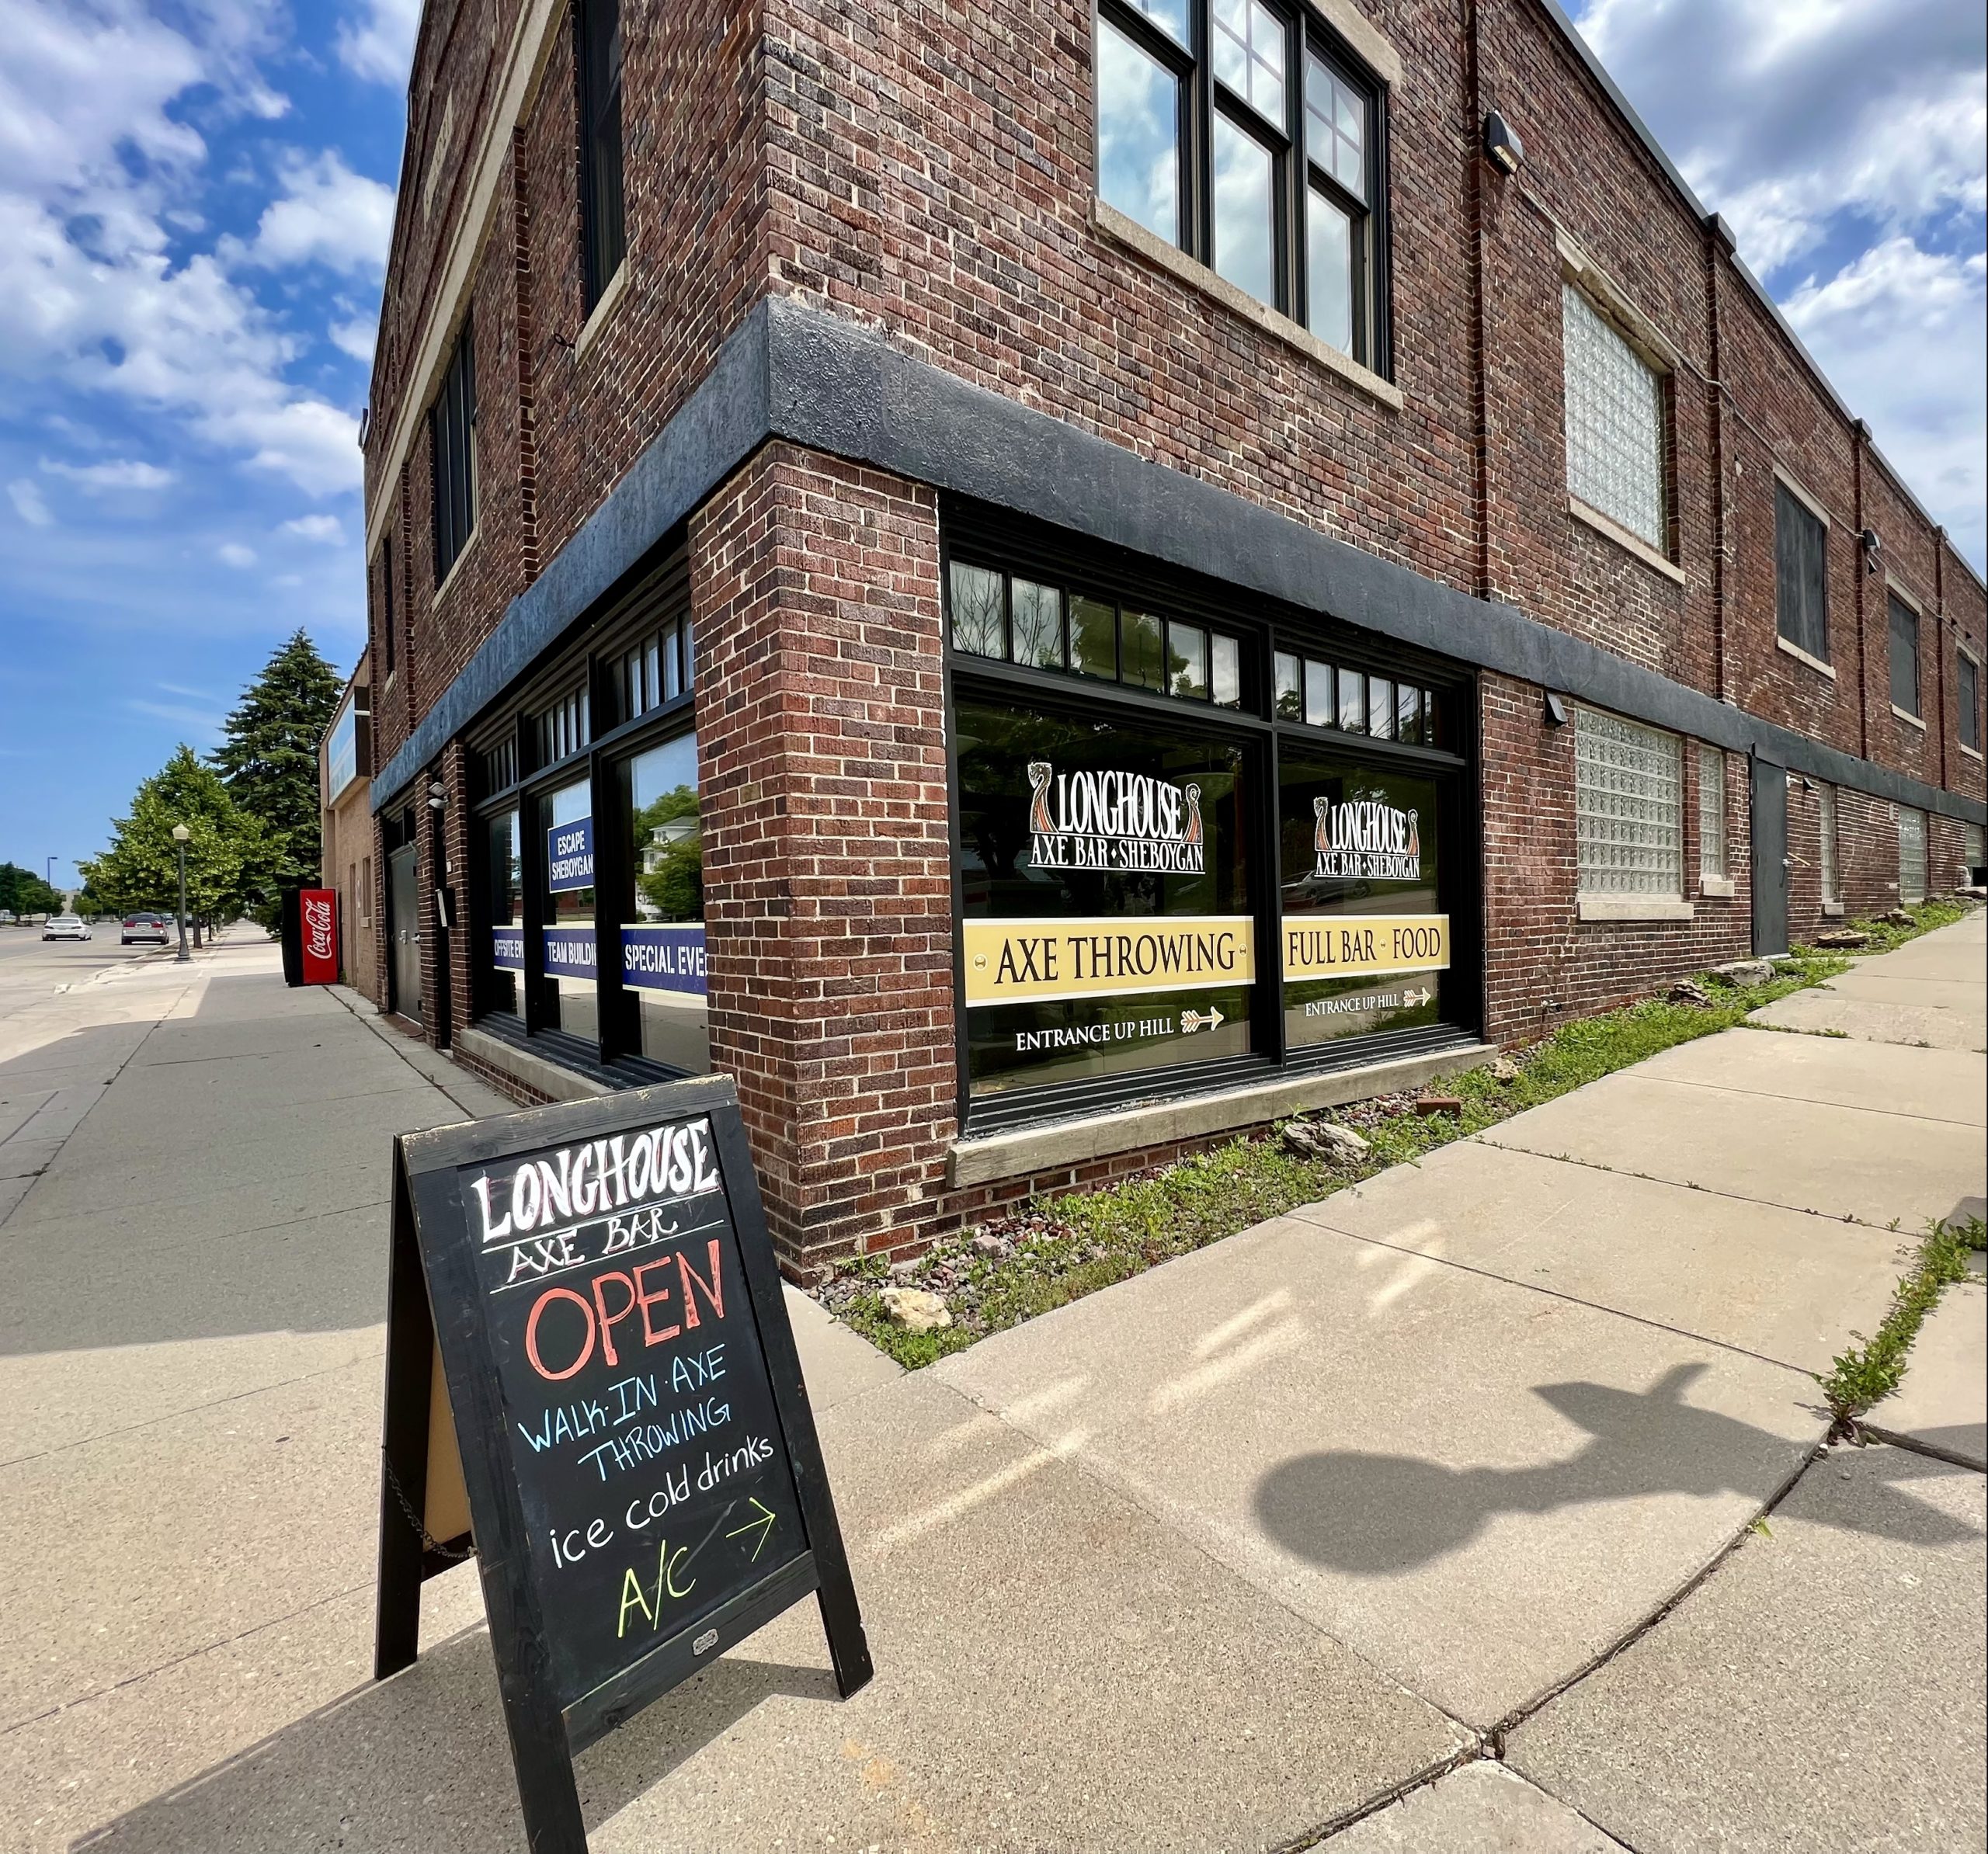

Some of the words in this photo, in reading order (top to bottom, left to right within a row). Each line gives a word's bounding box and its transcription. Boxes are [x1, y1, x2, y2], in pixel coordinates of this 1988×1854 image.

[1057, 770, 1183, 839] LONGHOUSE
[558, 830, 586, 856] ESCAPE
[1331, 801, 1407, 854] LONGHOUSE
[551, 853, 594, 881] SHEBOYGAN
[1030, 834, 1069, 865] AXE
[1074, 836, 1109, 867] BAR
[1118, 839, 1204, 871] SHEBOYGAN
[1315, 852, 1338, 875] AXE
[1340, 852, 1361, 876] BAR
[1367, 855, 1420, 878] SHEBOYGAN
[494, 939, 514, 958] OFFSITE
[547, 941, 567, 963] TEAM
[624, 943, 675, 974] SPECIAL
[994, 937, 1058, 984] AXE
[1067, 932, 1236, 979] THROWING
[1288, 931, 1336, 967] FULL
[1340, 929, 1377, 963] BAR
[1392, 928, 1441, 959] FOOD
[1303, 998, 1361, 1017] ENTRANCE
[1363, 995, 1376, 1010] UP
[1378, 994, 1399, 1008] HILL
[1016, 1024, 1110, 1051] ENTRANCE
[1114, 1021, 1136, 1040] UP
[1139, 1018, 1175, 1036] HILL
[471, 1118, 720, 1243] LONGHOUSE
[506, 1229, 586, 1283] AXE
[602, 1208, 679, 1254] BAR
[525, 1238, 725, 1380] OPEN
[577, 1397, 732, 1481] THROWING
[549, 1517, 614, 1568] ice
[626, 1463, 691, 1529] cold
[697, 1435, 774, 1491] drinks
[617, 1539, 697, 1638] A/C
